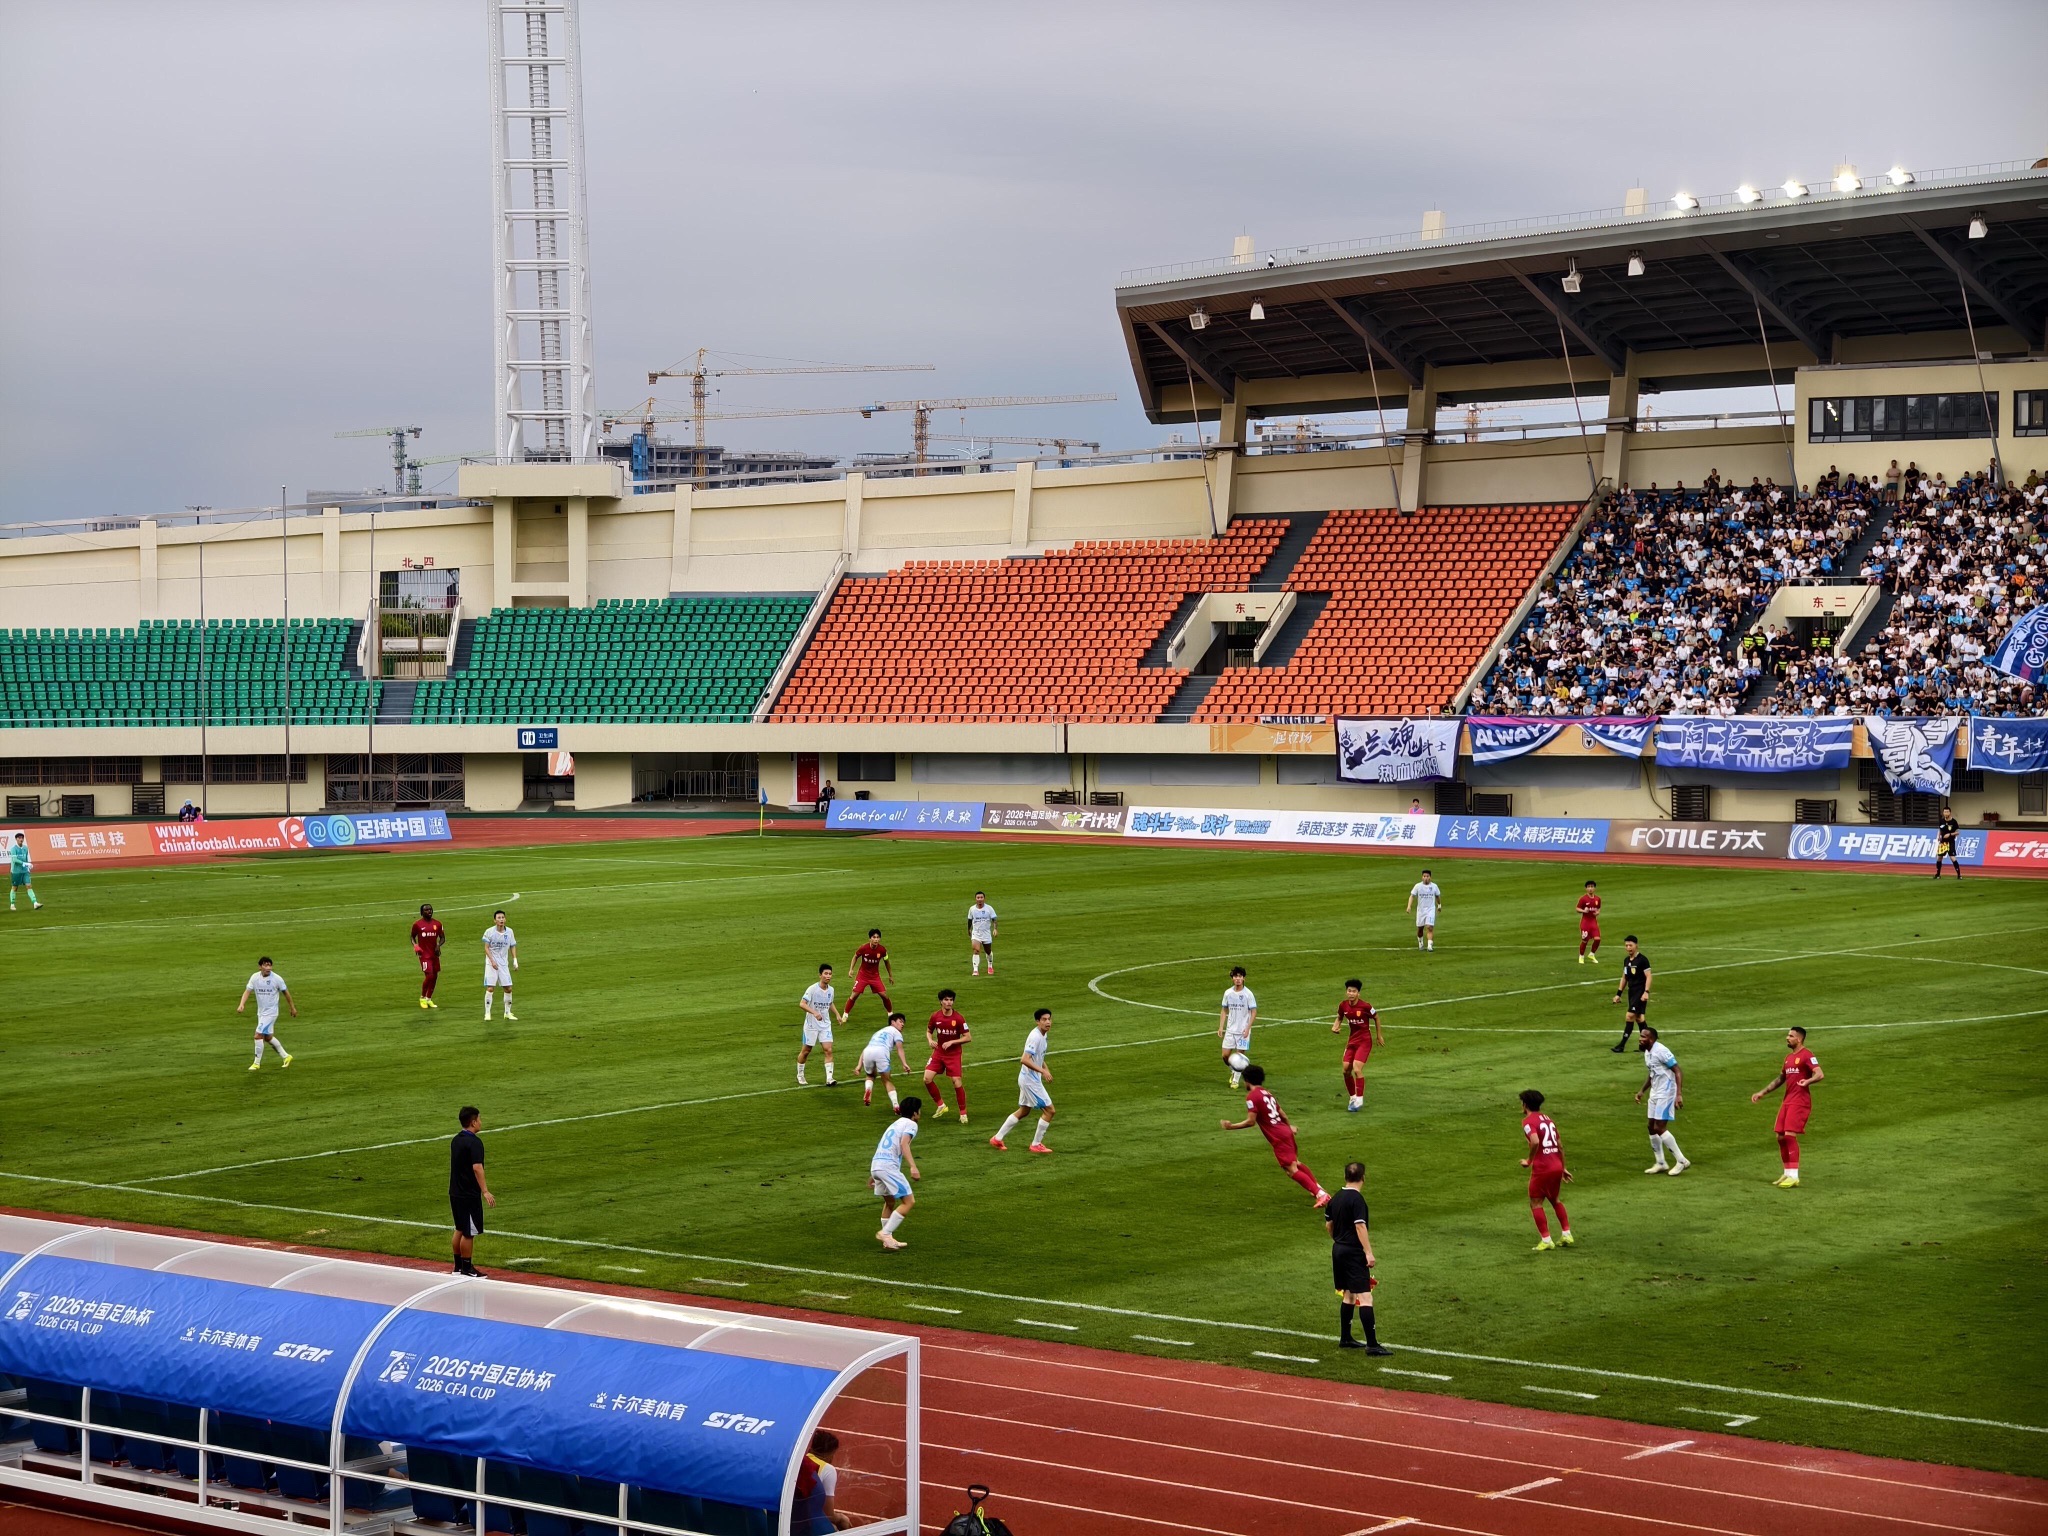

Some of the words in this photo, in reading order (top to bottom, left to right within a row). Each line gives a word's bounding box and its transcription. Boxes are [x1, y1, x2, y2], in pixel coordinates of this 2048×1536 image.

[402, 557, 434, 568] 北四
[1235, 603, 1266, 614] 东一
[1813, 596, 1846, 608] 东二
[1680, 749, 1725, 767] ALA
[1736, 752, 1826, 769] NINGBO
[838, 806, 865, 822] Game
[868, 809, 887, 823] for
[889, 808, 909, 822] all!
[916, 807, 972, 824] 全民足球
[1132, 812, 1176, 834] 魂斗士
[356, 817, 427, 840] 足球中国
[1296, 820, 1349, 837] 绿茵逐梦
[1630, 827, 1718, 849] FOTILE
[1719, 829, 1767, 850] 方太
[49, 831, 126, 849] 暖云科技
[159, 836, 281, 853] chinafootball.com.cn
[1994, 841, 2048, 859] sta
[881, 1129, 895, 1149] 8
[43, 1295, 155, 1327] 2026中国足协杯
[35, 1314, 60, 1328] 2026
[60, 1319, 80, 1332] CFA
[80, 1322, 103, 1335] CUP
[198, 1327, 263, 1352] 卡尔美体育
[272, 1342, 335, 1362] star
[422, 1355, 556, 1392] 2026中国足协杯
[414, 1376, 444, 1392] 2026
[444, 1382, 468, 1397] CFA
[470, 1385, 496, 1401] CUP
[611, 1393, 688, 1421] 卡尔美体育
[702, 1411, 775, 1434] star
